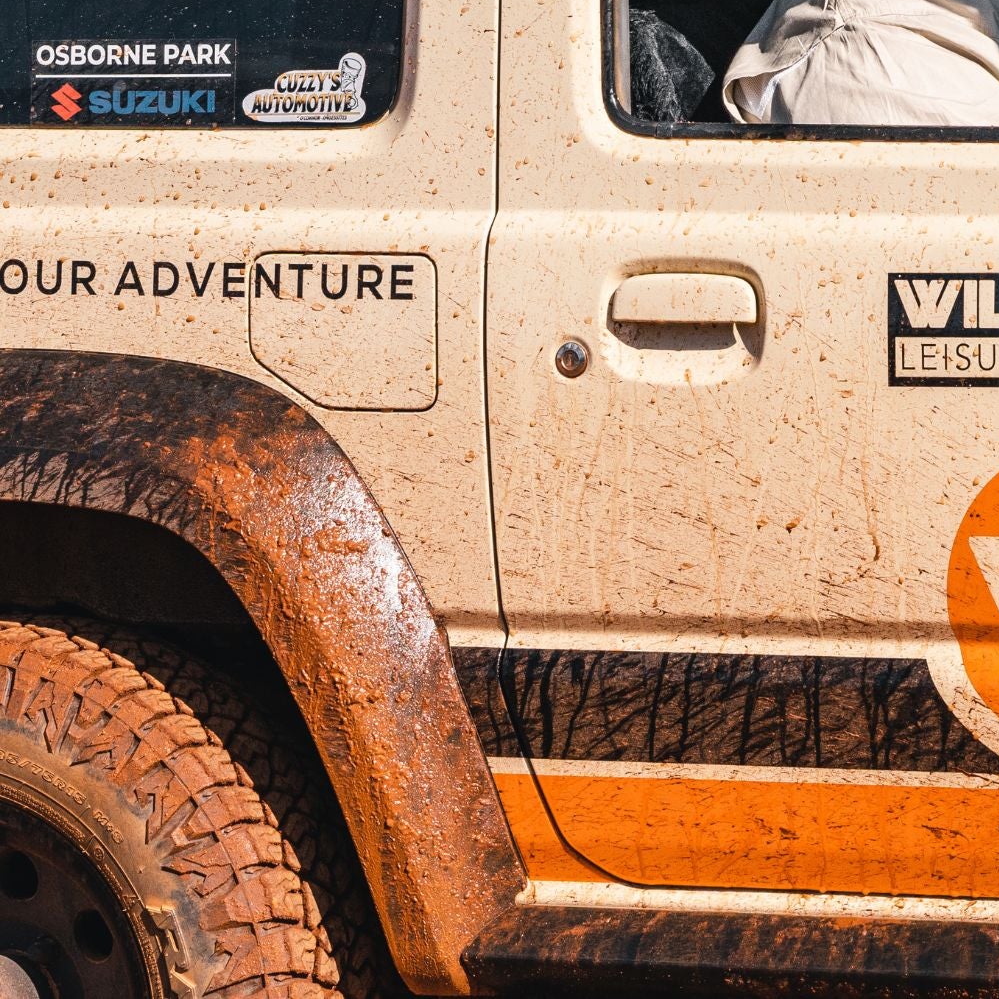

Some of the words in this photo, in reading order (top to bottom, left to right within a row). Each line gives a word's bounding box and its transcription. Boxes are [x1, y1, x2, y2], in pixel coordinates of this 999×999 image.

[36, 44, 156, 66] OSBORNE
[163, 43, 231, 65] PARK
[276, 72, 341, 93] CUZZY'S
[88, 89, 216, 115] SUZUKI
[251, 92, 353, 113] AUTOMOTIVE
[0, 259, 97, 296] OUR
[114, 261, 414, 300] ADVENTURE
